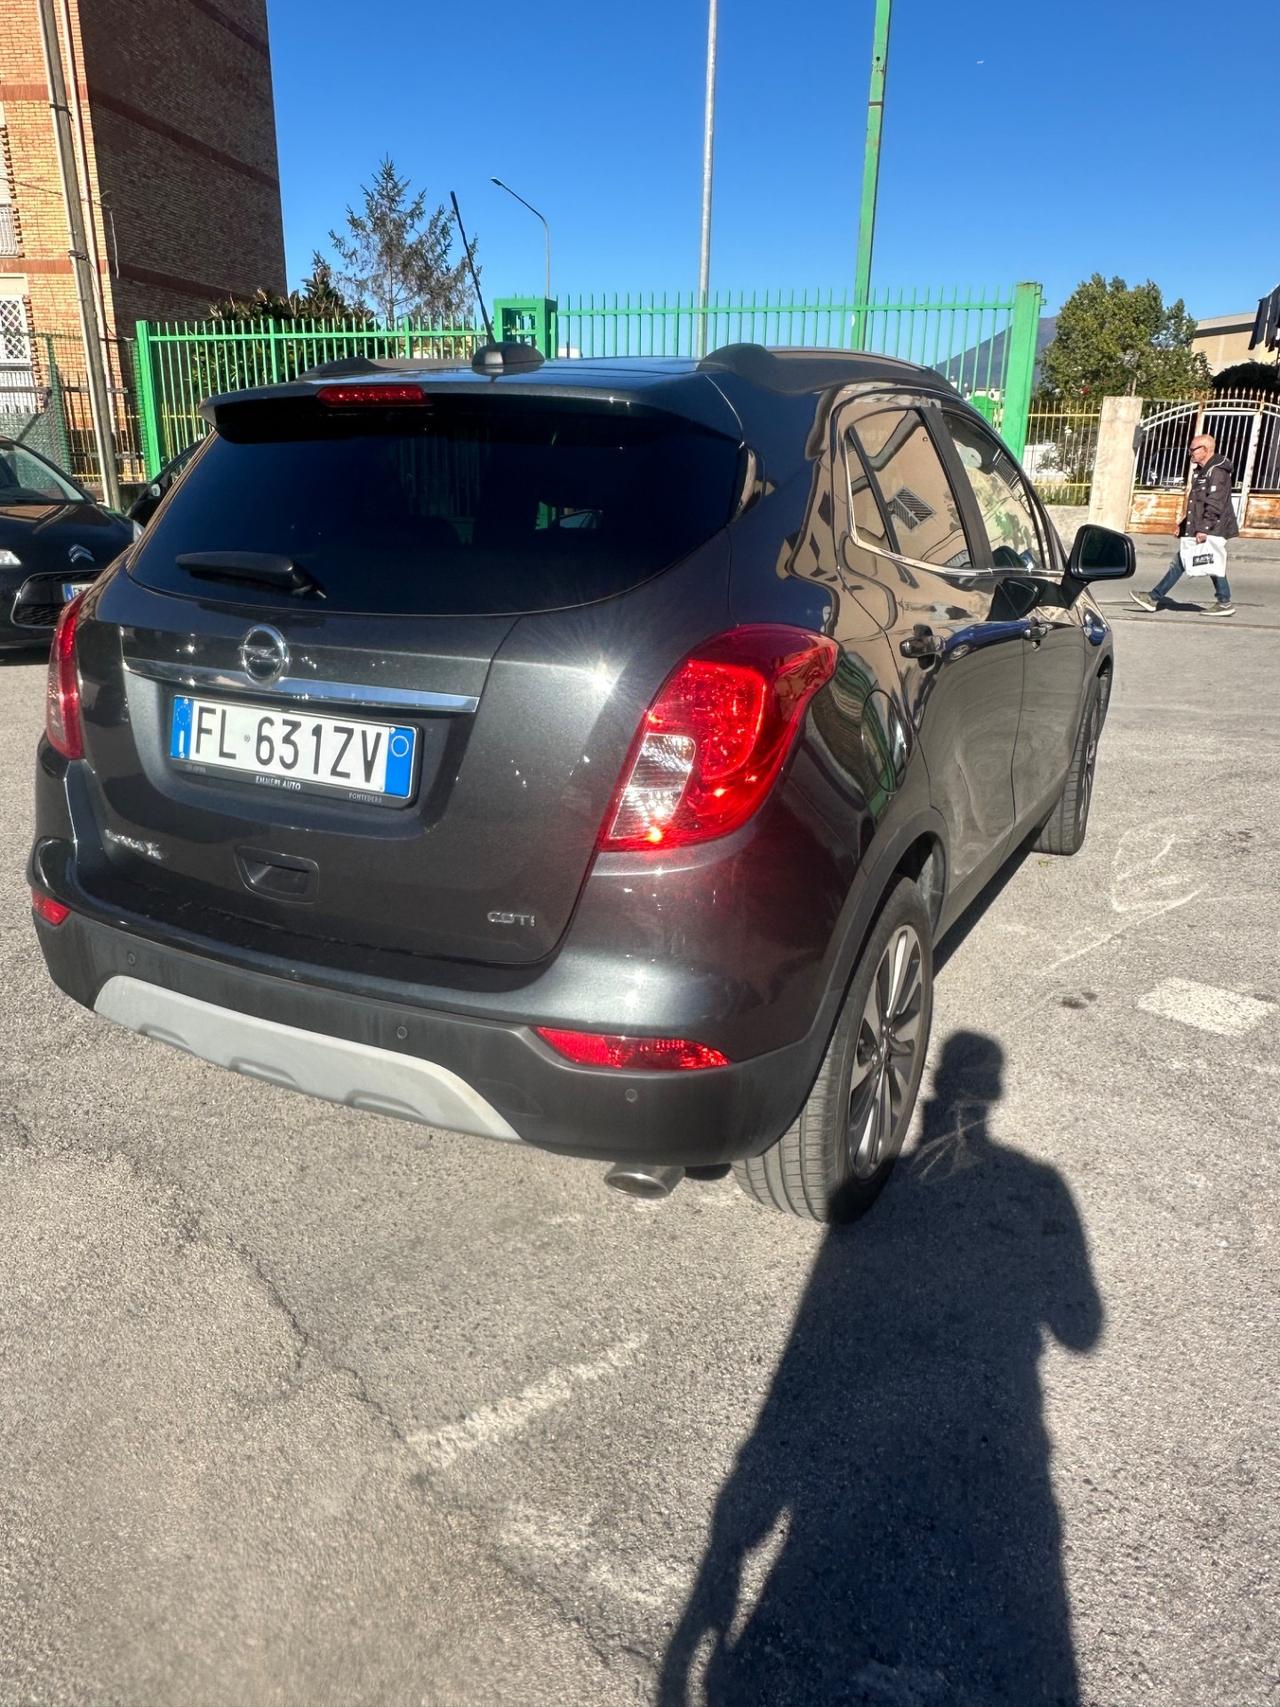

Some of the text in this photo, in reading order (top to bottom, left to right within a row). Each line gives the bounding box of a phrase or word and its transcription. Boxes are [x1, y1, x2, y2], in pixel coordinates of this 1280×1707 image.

[195, 706, 382, 784] FL 631ZV
[282, 779, 301, 790] AUTO
